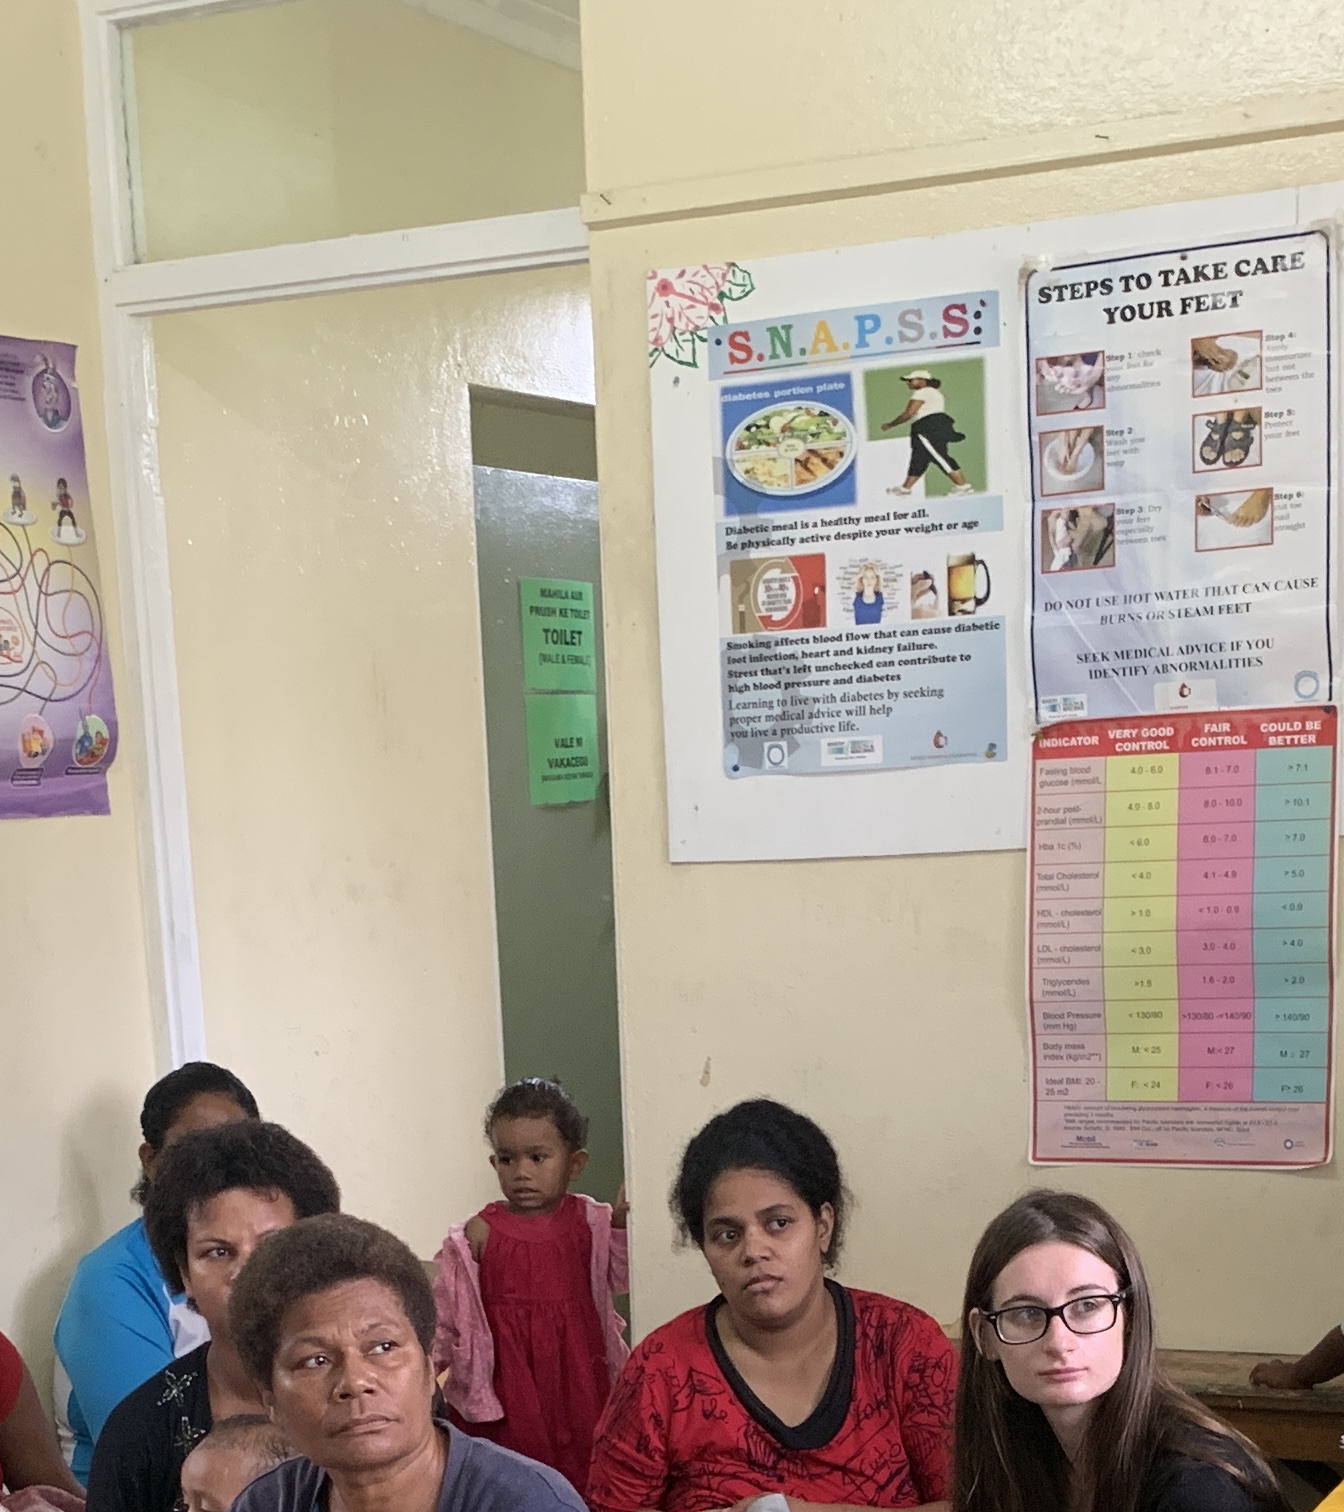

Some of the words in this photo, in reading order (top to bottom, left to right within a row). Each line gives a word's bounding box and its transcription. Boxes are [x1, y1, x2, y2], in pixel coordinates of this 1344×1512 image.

[1038, 278, 1113, 304] STEPS
[1119, 273, 1152, 292] TO
[1158, 261, 1228, 286] TAKE
[1234, 251, 1305, 277] CARE
[1104, 300, 1174, 324] YOUR
[1180, 290, 1243, 315] FEET
[1265, 333, 1286, 344] Step
[1106, 353, 1125, 364] Step
[721, 390, 770, 402] diabetes
[774, 386, 813, 398] portion
[817, 381, 845, 394] plate
[1106, 428, 1125, 439] Step
[1116, 507, 1136, 517] Step
[725, 523, 769, 536] Diabetic
[772, 520, 798, 531] meal
[821, 516, 860, 530] healthy
[864, 512, 890, 523] meal
[893, 510, 909, 521] for
[741, 535, 796, 551] physically
[799, 532, 831, 543] active
[834, 528, 872, 543] despite
[875, 526, 901, 538] your
[904, 522, 943, 536] weight
[1044, 601, 1062, 612] DO
[1066, 599, 1092, 610] NOT
[1096, 596, 1119, 608] USE
[1124, 593, 1151, 605] HOT
[1155, 588, 1200, 602] WATER
[1205, 584, 1238, 598] THAT
[1242, 582, 1270, 595] CAN
[1274, 577, 1318, 592] CAUSE
[1100, 612, 1142, 626] BURNS
[1147, 609, 1164, 621] OR
[1168, 605, 1215, 619] STEAM
[1218, 602, 1252, 615] FEET
[543, 628, 582, 646] TOILET
[774, 634, 810, 647] affects
[812, 633, 843, 644] blood
[846, 631, 871, 641] flow
[874, 629, 897, 640] that
[954, 621, 1000, 633] diabetic
[801, 648, 830, 660] heart
[833, 646, 854, 657] and
[856, 642, 894, 656] kidney
[1076, 652, 1110, 664] SEEK
[1114, 646, 1174, 662] MEDICAL
[1177, 642, 1227, 657] ADVICE
[1246, 639, 1274, 650] YOU
[793, 663, 811, 675] left
[815, 658, 873, 673] unchecked
[898, 653, 957, 666] contribute
[1089, 664, 1150, 679] IDENTIFY
[1153, 656, 1263, 675] ABNORMALITIES
[728, 683, 750, 694] high
[753, 680, 781, 692] blood
[784, 677, 830, 690] pressure
[833, 675, 853, 685] and
[856, 672, 901, 684] diabetes
[790, 694, 808, 706] live
[812, 692, 837, 704] with
[840, 688, 885, 703] diabetes
[887, 689, 899, 702] by
[902, 686, 944, 700] seeking
[765, 709, 804, 723] medical
[808, 706, 842, 719] advice
[845, 704, 866, 717] will
[869, 703, 892, 717] help
[751, 724, 769, 737] live
[780, 721, 836, 737] productive
[1108, 729, 1138, 739] VERY
[1141, 726, 1174, 737] GOOD
[1204, 723, 1230, 733] FAIR
[1260, 722, 1302, 733] COULD
[1306, 721, 1321, 731] BE
[1039, 736, 1099, 748] INDICATOR
[1115, 740, 1170, 752] CONTROL
[1192, 735, 1247, 747] CONTROL
[1269, 735, 1316, 746] BETTER
